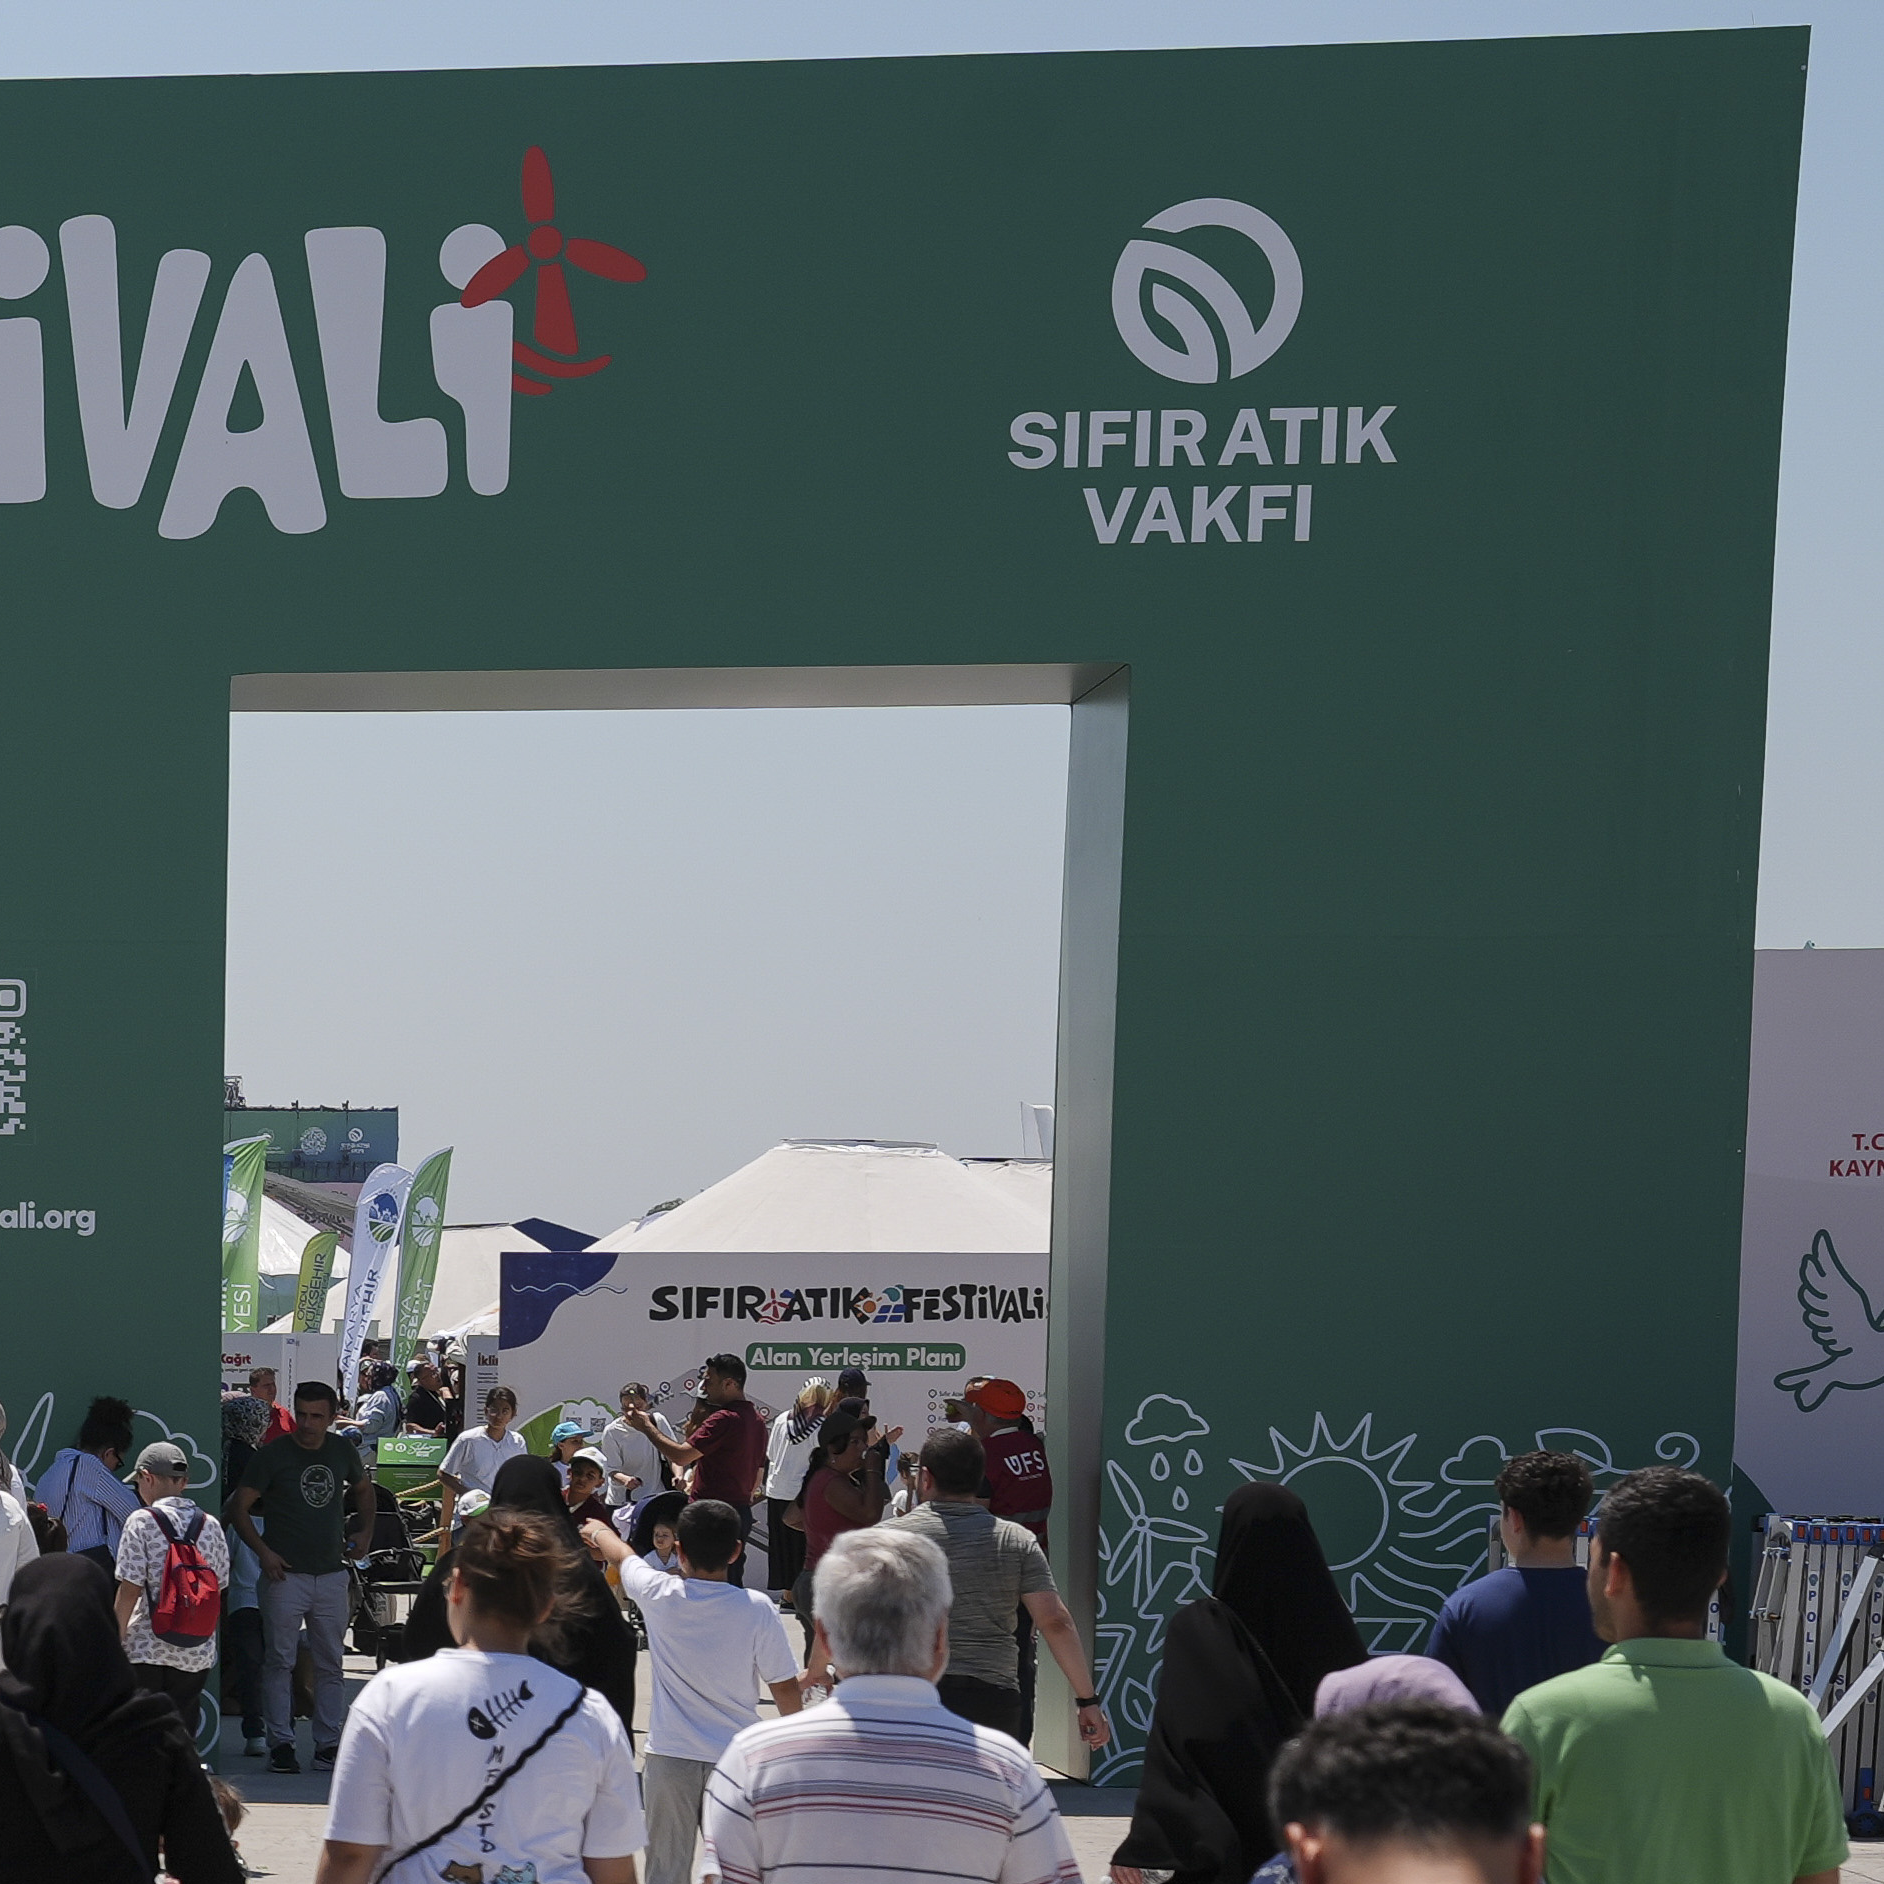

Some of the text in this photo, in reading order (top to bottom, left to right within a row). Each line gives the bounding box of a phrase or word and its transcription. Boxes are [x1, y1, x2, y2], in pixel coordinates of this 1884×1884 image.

[1007, 405, 1399, 470] SIFIR ATIK
[1082, 484, 1313, 545] VAKFI
[648, 1284, 767, 1324] SIFIR
[779, 1286, 873, 1325] ATIK
[750, 1347, 961, 1371] Alan Yerleşim Planı
